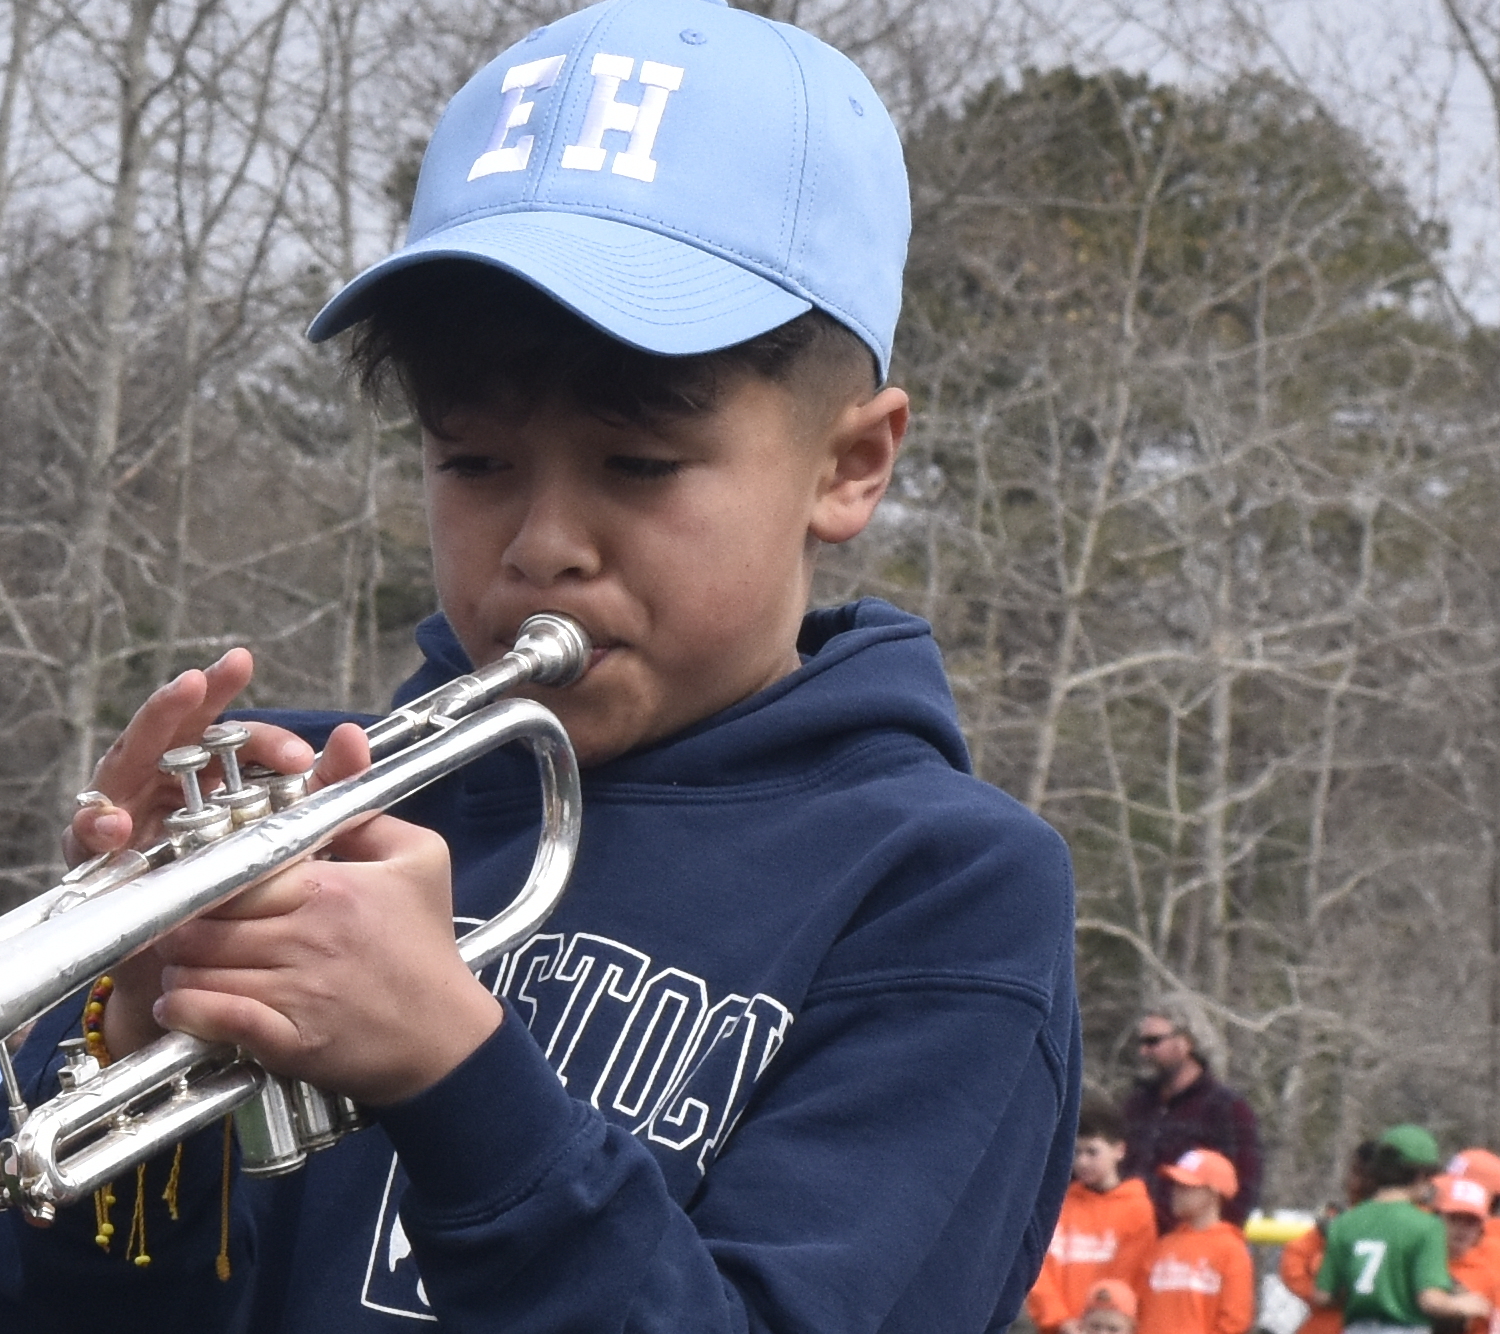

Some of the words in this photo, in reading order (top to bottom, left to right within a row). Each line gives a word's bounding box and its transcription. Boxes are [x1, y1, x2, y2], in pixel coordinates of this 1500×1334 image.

[467, 52, 685, 183] EH
[453, 916, 794, 1175] STOC
[1354, 1240, 1387, 1295] 7
